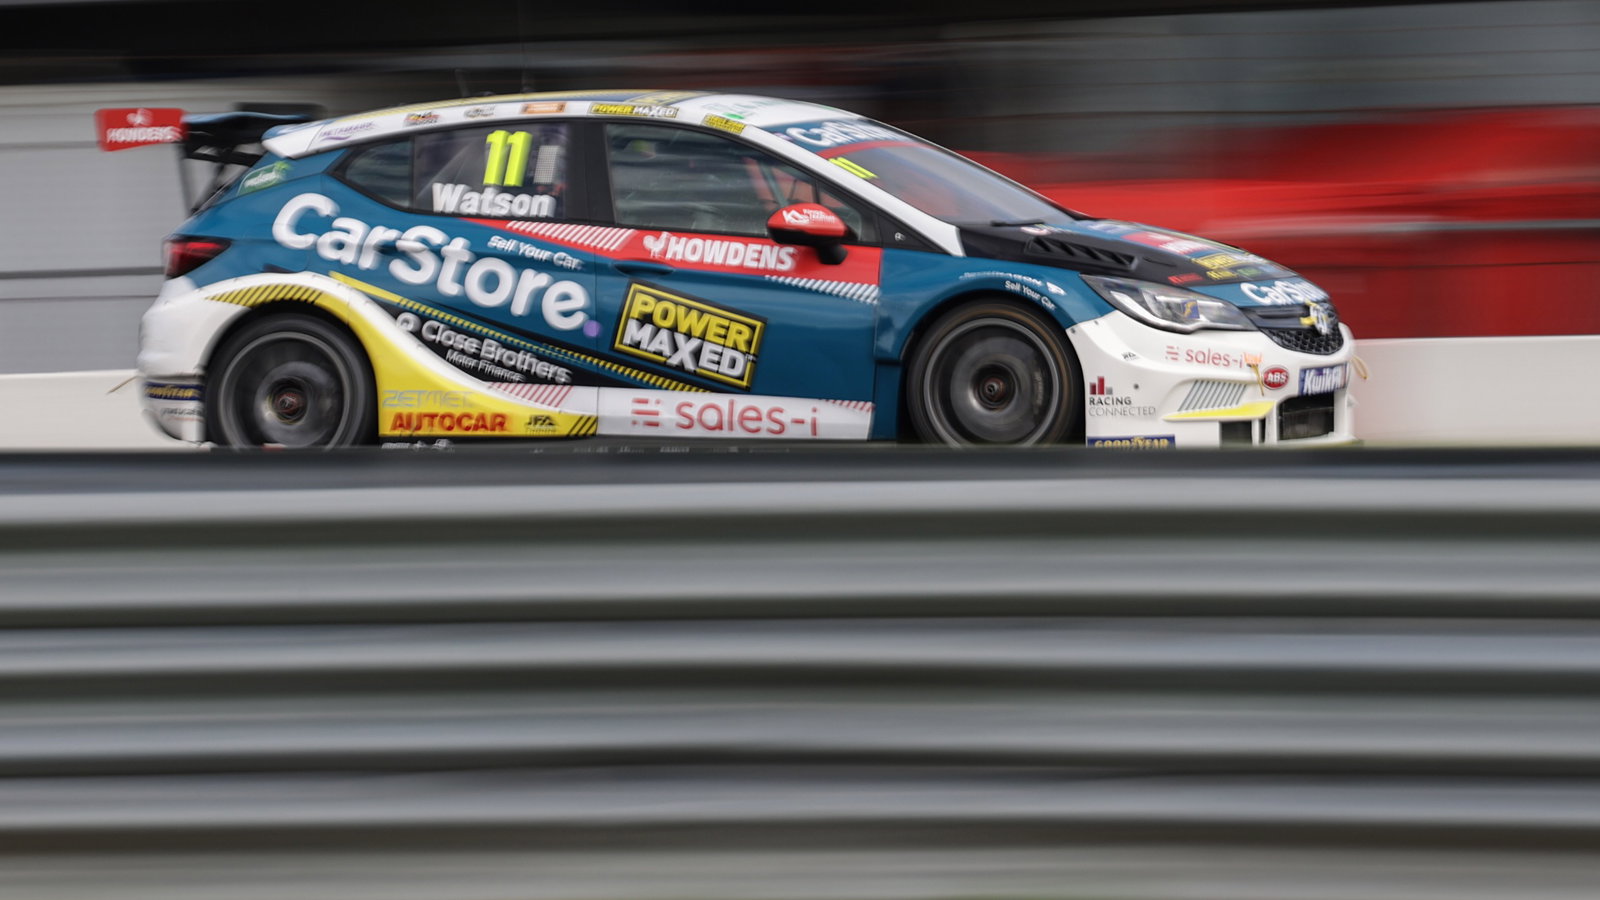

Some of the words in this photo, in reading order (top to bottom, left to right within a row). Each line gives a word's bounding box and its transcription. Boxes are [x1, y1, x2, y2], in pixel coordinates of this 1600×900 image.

[591, 103, 634, 114] POWER
[632, 104, 676, 118] MAXED
[483, 130, 533, 187] 11
[432, 182, 557, 218] Watson
[487, 234, 518, 251] Sell
[518, 241, 553, 260] Your
[665, 236, 797, 272] HOWDENS
[1004, 280, 1021, 292] Sell
[1022, 285, 1041, 300] Your
[629, 292, 753, 353] POWER
[421, 320, 483, 355] Close
[479, 338, 573, 384] Brothers
[622, 318, 747, 378] MAXED
[1185, 347, 1244, 369] sales-i
[446, 349, 477, 369] Motor
[477, 358, 527, 383] Finance
[1266, 371, 1287, 384] ABS
[1088, 406, 1157, 417] CONNECTED
[1089, 396, 1132, 406] RACING
[389, 412, 508, 432] AUTOCAR
[675, 399, 819, 437] sales-i
